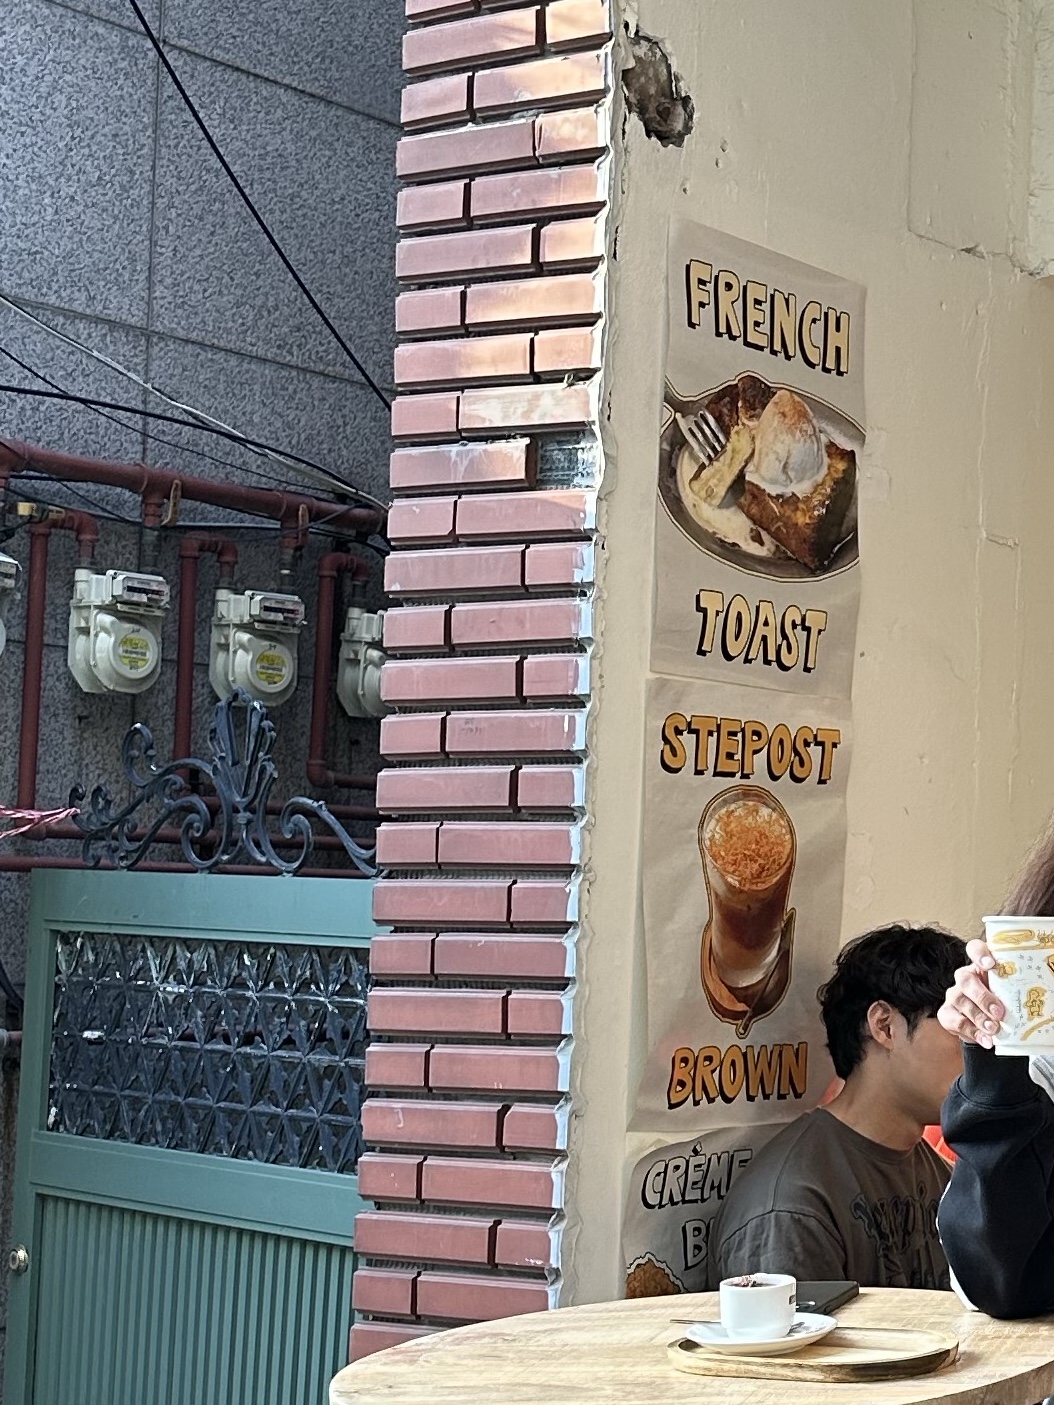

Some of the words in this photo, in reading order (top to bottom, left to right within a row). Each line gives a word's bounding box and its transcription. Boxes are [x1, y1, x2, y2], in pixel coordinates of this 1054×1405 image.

[685, 258, 850, 376] FRENCH
[696, 588, 828, 673] TOAST
[660, 711, 841, 785] STEPOST
[667, 1041, 808, 1110] BROWN
